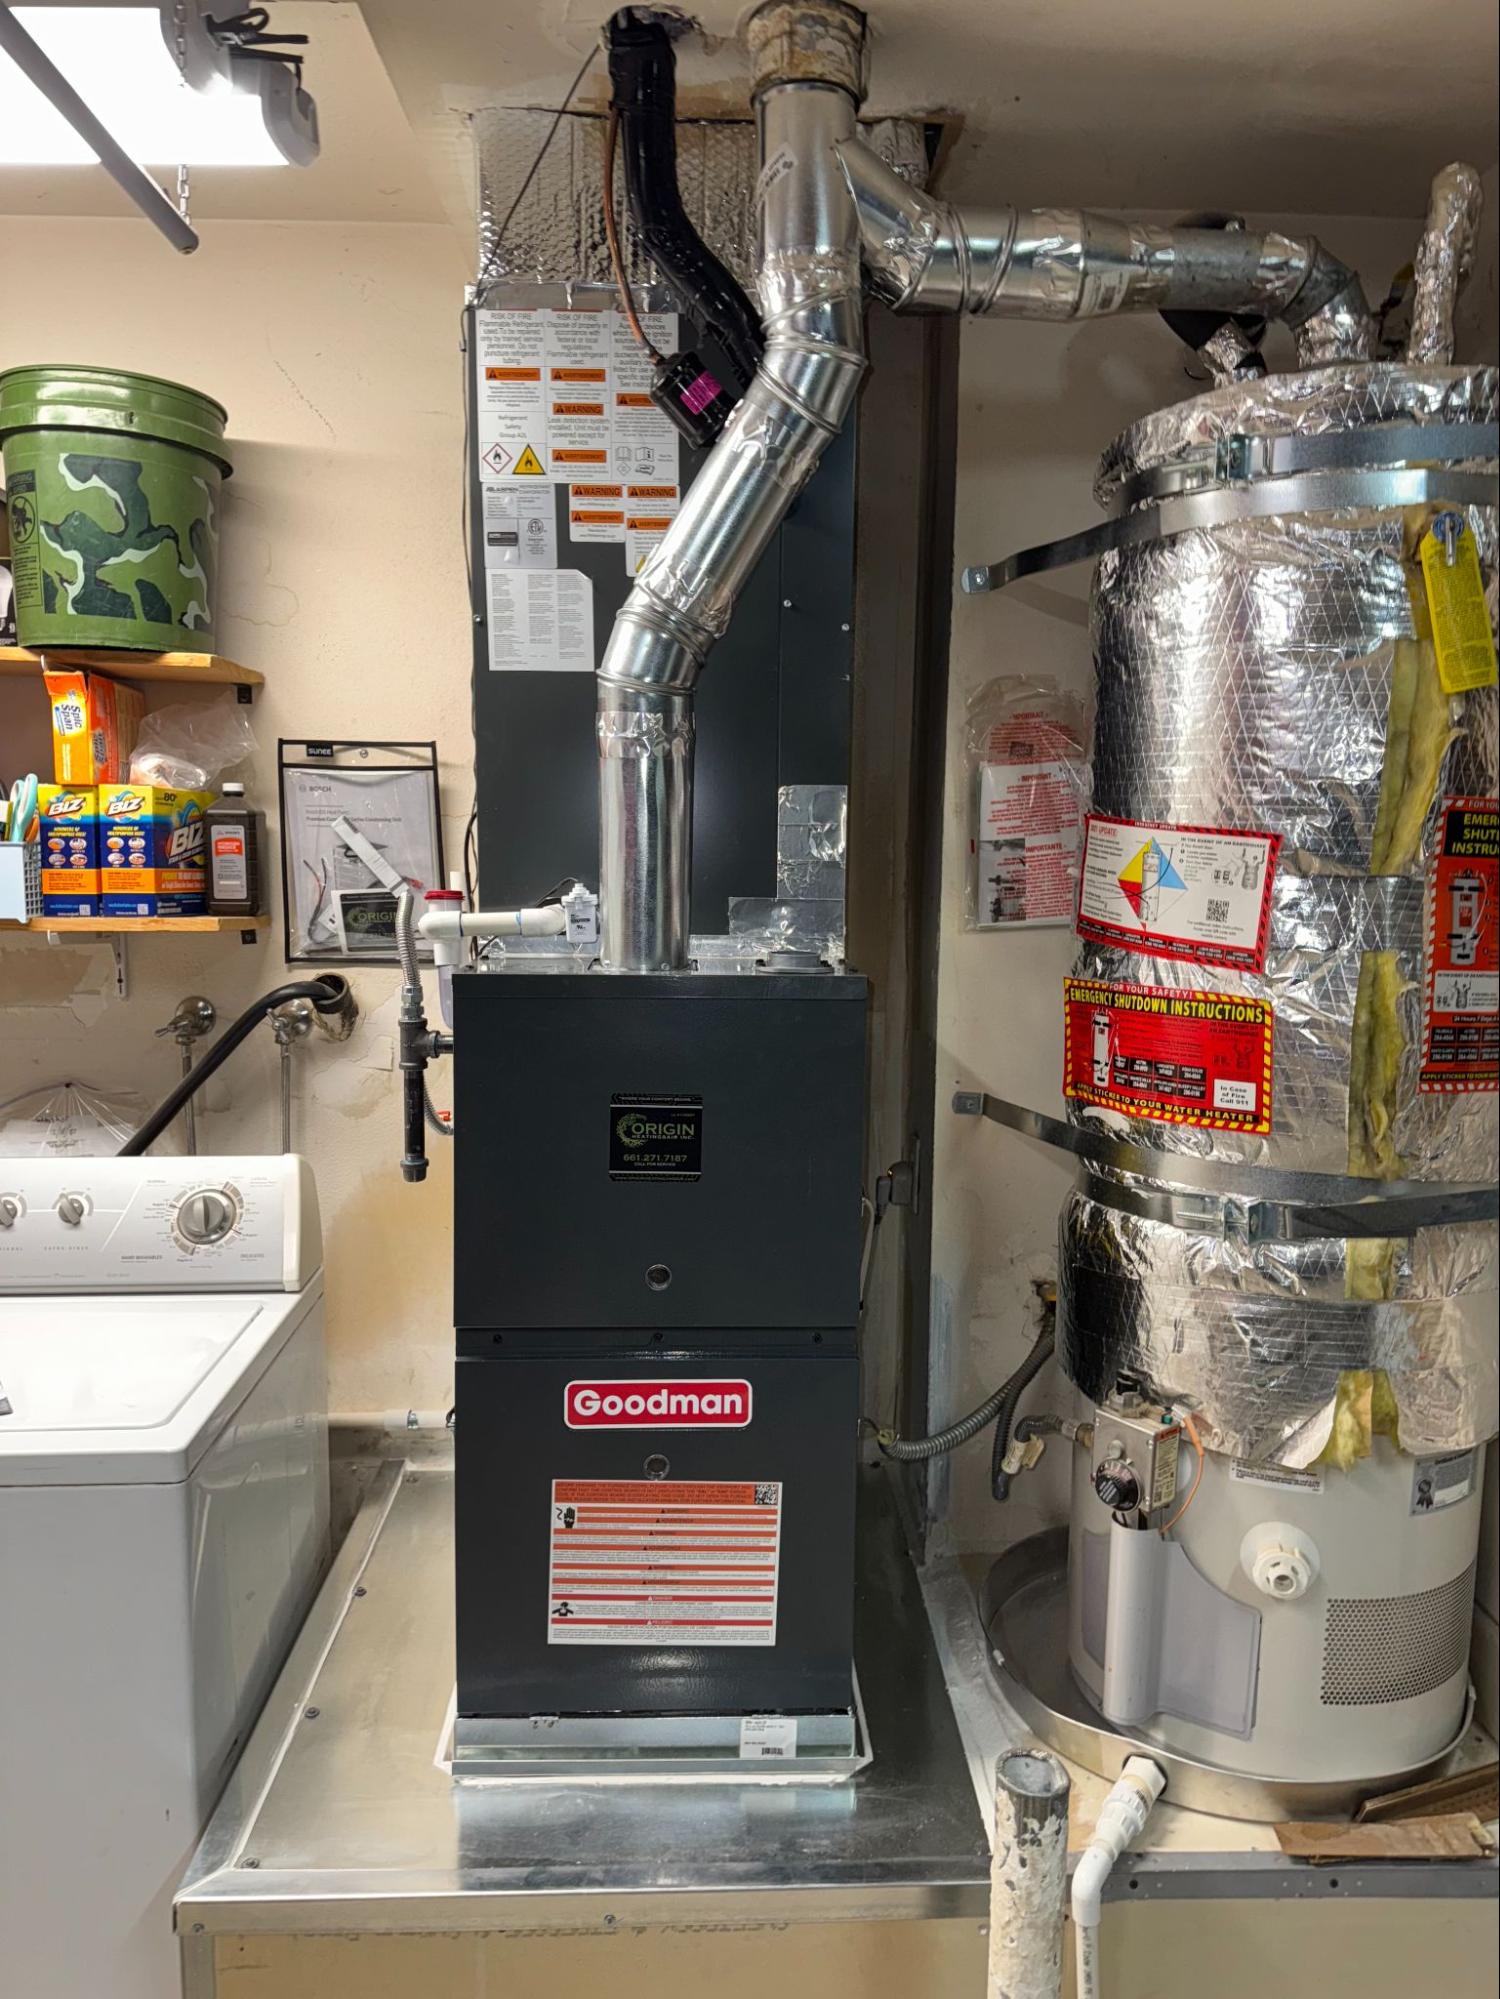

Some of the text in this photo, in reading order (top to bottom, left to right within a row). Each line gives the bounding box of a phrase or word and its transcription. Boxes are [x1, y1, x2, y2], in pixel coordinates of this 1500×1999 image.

[565, 404, 601, 414] WARNING
[583, 487, 620, 496] WARNING
[637, 488, 676, 497] WARNING
[308, 785, 332, 793] BOSCH
[1463, 813, 1499, 826] EMER
[1451, 841, 1499, 855] INSTRU
[1109, 983, 1193, 1000] FOR YOUR SAFETY!
[1070, 987, 1263, 1023] EMERGENCY SHUTDOWN INSTRUCTIONS
[1121, 1096, 1131, 1104] TO
[1133, 1098, 1162, 1110] YOUR
[1164, 1103, 1201, 1116] WATER
[1205, 1110, 1254, 1122] HEATER
[631, 1122, 695, 1136] ORIGIN
[573, 1388, 743, 1417] Goodman
